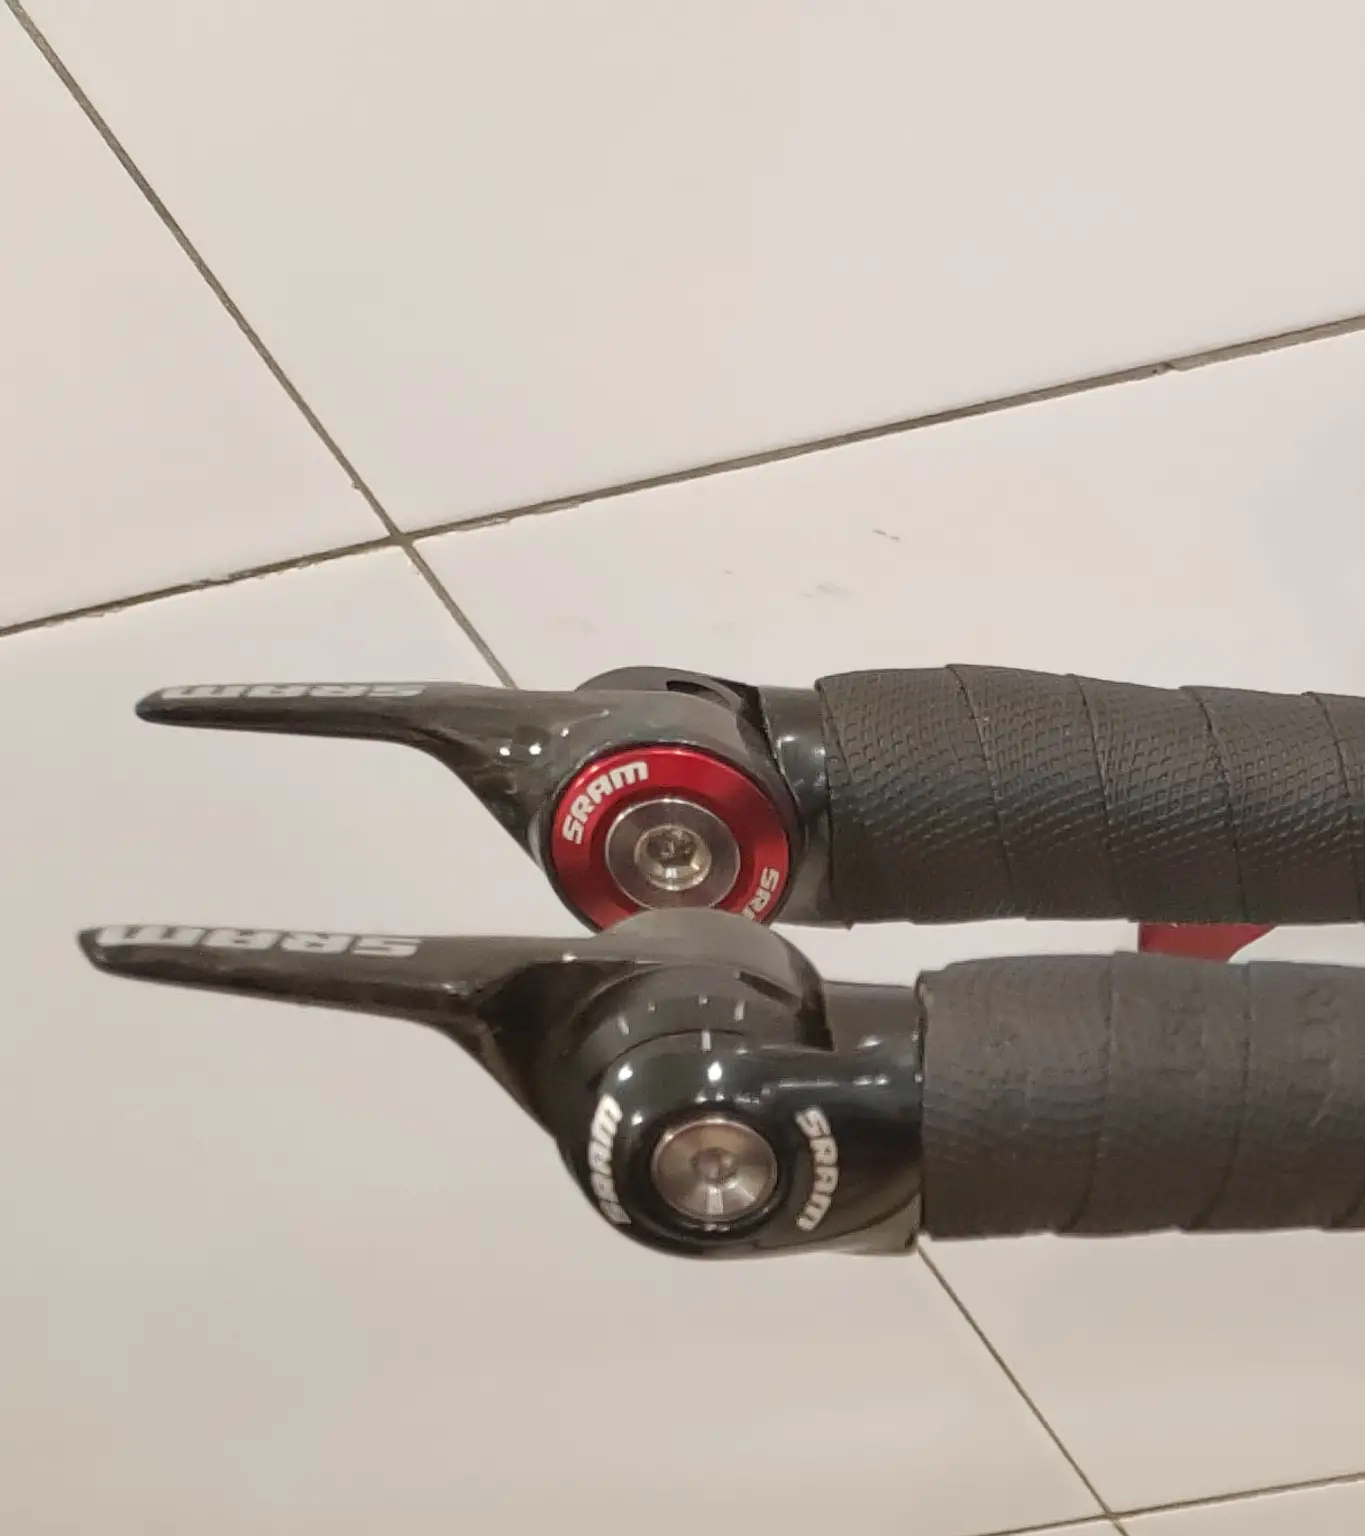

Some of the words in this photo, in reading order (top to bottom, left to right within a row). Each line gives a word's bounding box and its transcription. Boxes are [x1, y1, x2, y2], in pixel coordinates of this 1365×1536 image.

[562, 760, 650, 845] SRAM
[95, 924, 424, 957] SRAM
[795, 1105, 839, 1232] SRAM
